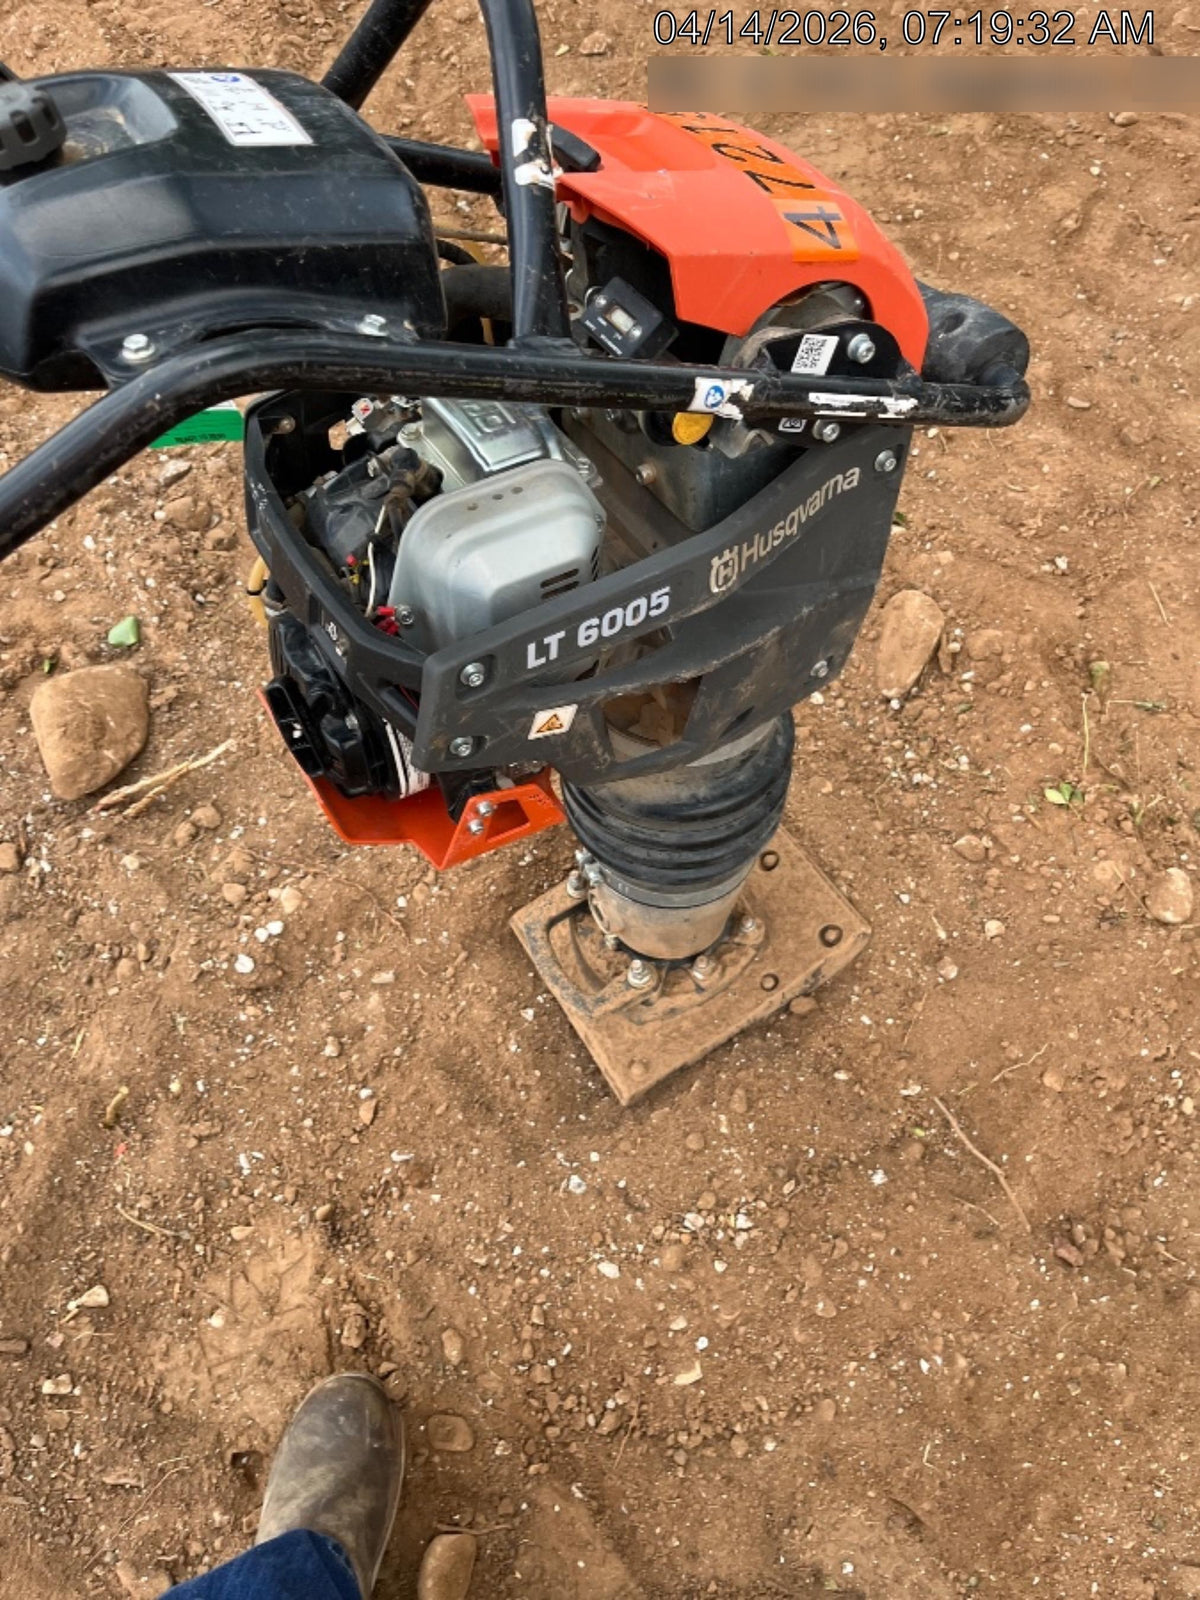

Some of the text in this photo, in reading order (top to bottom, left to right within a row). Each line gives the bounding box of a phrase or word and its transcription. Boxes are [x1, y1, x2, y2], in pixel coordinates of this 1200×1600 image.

[656, 111, 842, 250] 4721
[740, 466, 861, 573] Husqvarna
[526, 585, 671, 669] LT 6005
